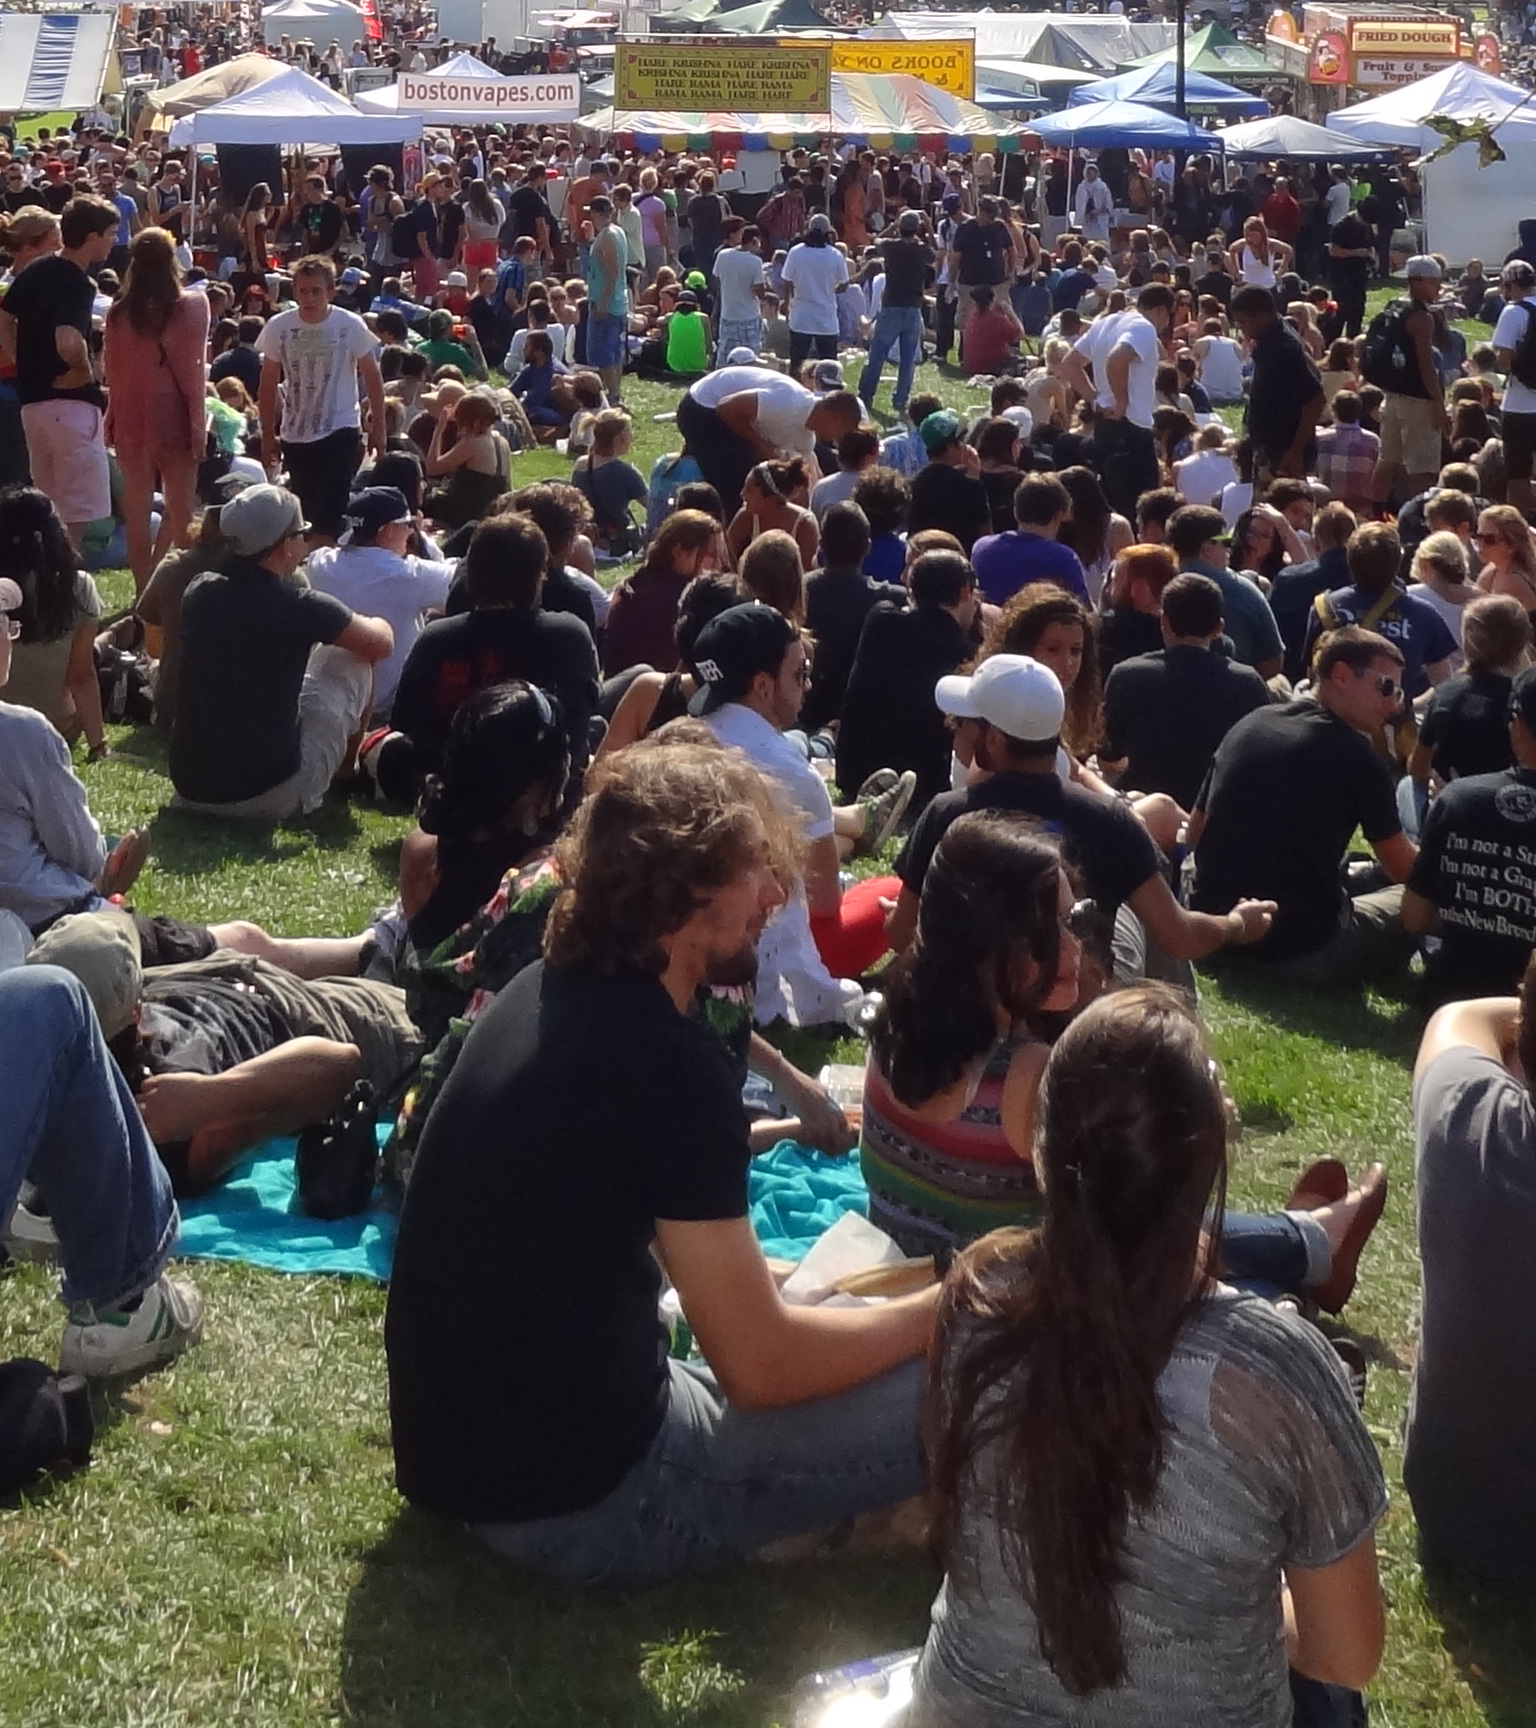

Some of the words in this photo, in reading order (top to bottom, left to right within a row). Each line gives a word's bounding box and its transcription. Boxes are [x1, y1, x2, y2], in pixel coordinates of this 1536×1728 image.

[1358, 32, 1399, 42] FRIED
[1401, 33, 1452, 43] DOUGH
[638, 58, 668, 68] HARE
[672, 59, 722, 69] KRISHNA
[727, 60, 758, 70] HARE
[762, 61, 811, 70] KRISHNA
[1362, 61, 1396, 72] Fruit
[638, 68, 688, 78] KRISHNA
[691, 69, 740, 79] KRISHNA
[745, 70, 775, 80] HARE
[779, 71, 809, 80] HARE
[655, 78, 686, 88] HARE
[690, 79, 722, 89] RAMA
[727, 80, 758, 90] HARE
[761, 80, 794, 90] RAMA
[404, 78, 574, 107] bostonvapes.com
[655, 89, 688, 99] RAMA
[690, 89, 723, 99] RAMA
[1446, 832, 1468, 850] I'm
[1472, 839, 1499, 856] not
[1503, 846, 1512, 858] a
[1440, 855, 1459, 874] I'm
[1462, 862, 1487, 879] not
[1490, 869, 1499, 881] a
[1454, 881, 1479, 903] I'm
